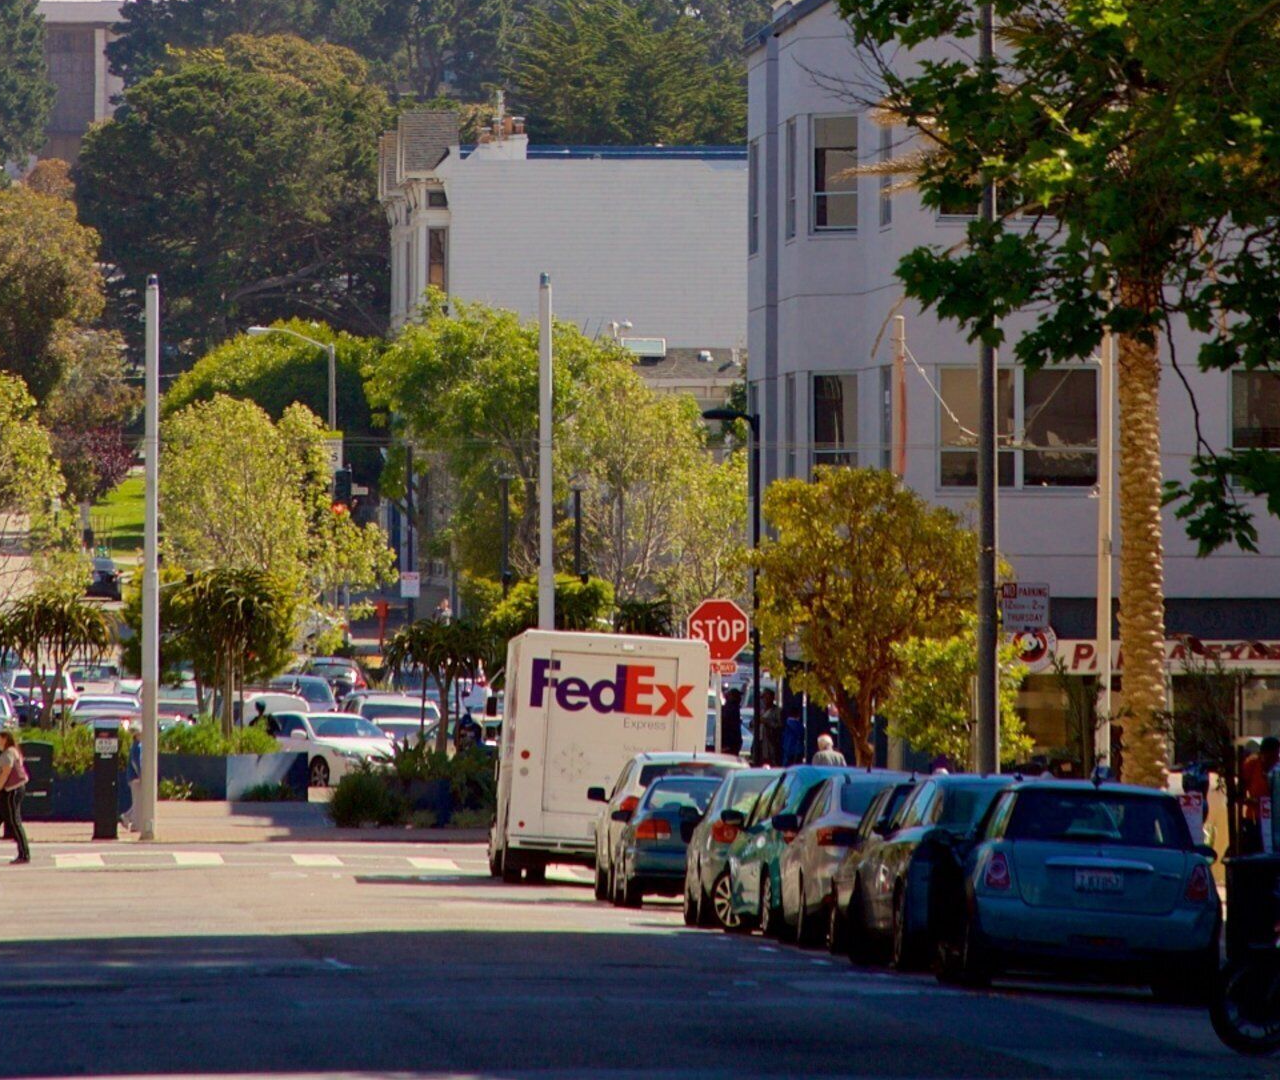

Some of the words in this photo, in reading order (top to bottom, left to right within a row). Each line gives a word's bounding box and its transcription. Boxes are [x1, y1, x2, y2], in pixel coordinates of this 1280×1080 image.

[1004, 584, 1016, 597] NO
[1019, 587, 1048, 597] PARKING
[1007, 614, 1042, 622] THURSDAY
[691, 619, 745, 642] STOP
[529, 658, 695, 717] FedEx
[623, 717, 666, 731] Express
